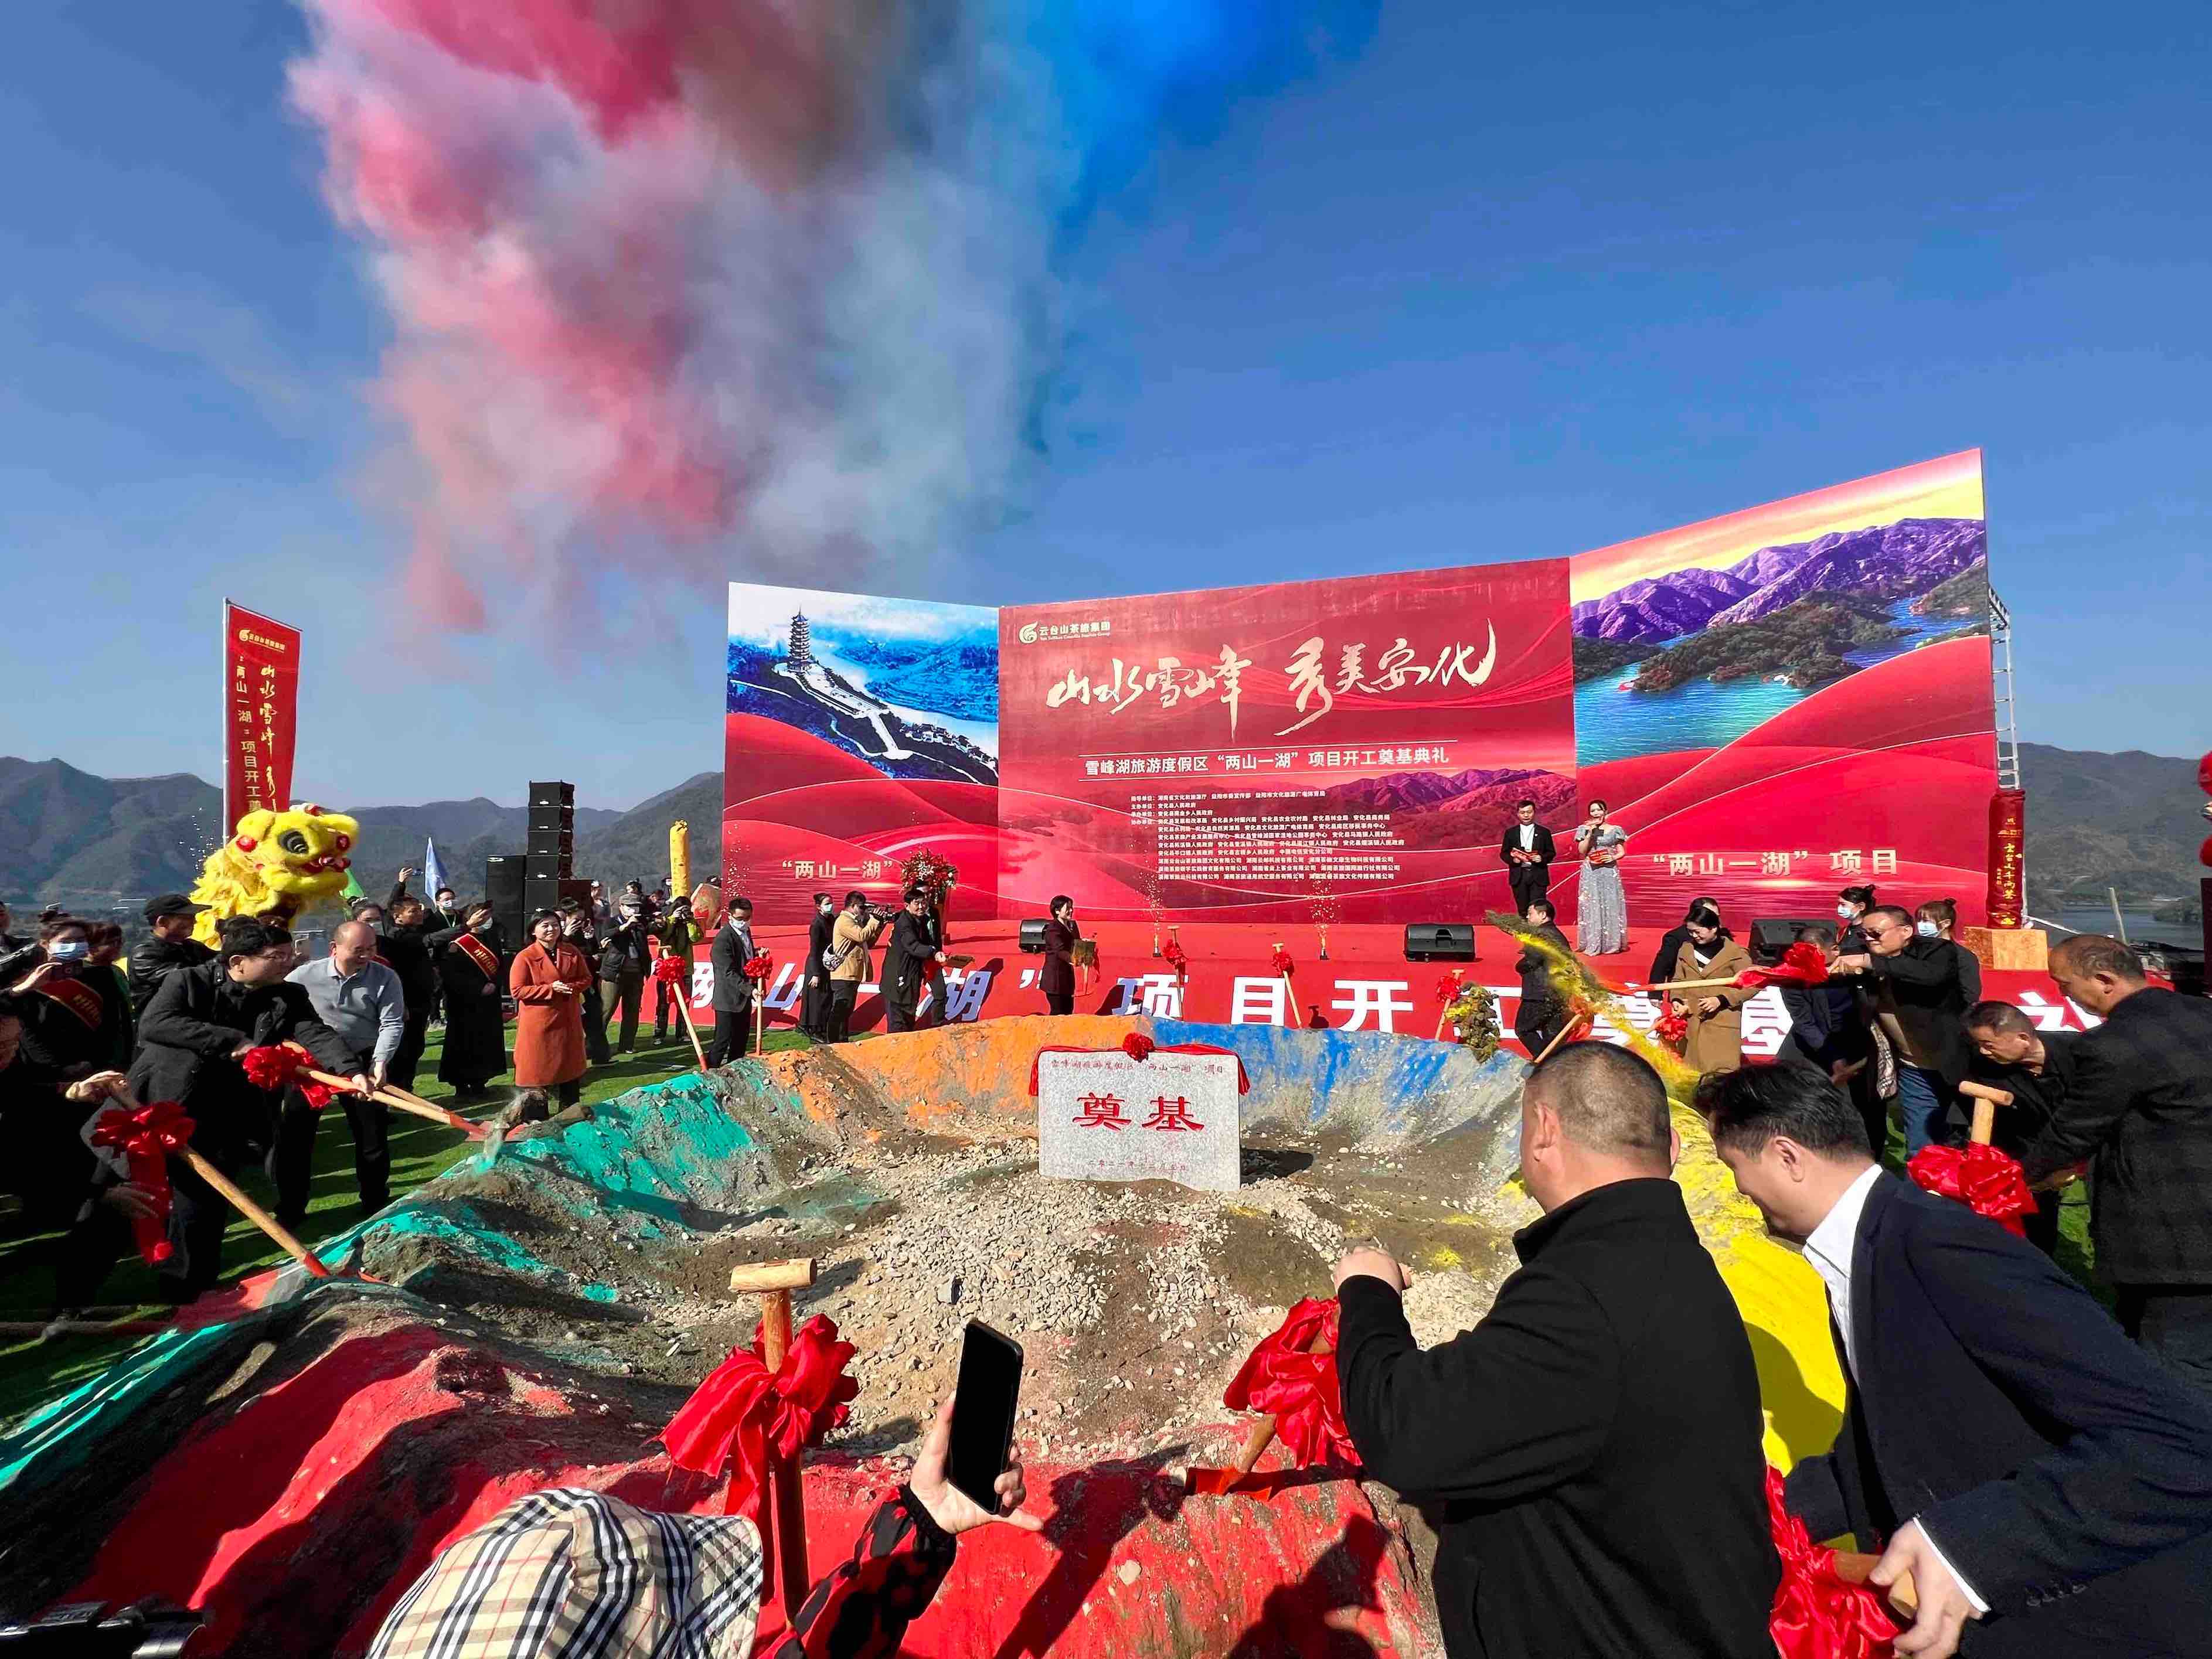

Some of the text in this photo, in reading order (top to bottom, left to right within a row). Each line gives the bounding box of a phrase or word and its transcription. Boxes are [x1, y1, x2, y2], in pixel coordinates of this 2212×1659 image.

[1039, 622, 1111, 636] 云台山茶旅集团
[1046, 617, 1496, 741] 山水雪峰 秀美安化
[782, 860, 893, 880] “两山一湖”
[1072, 1092, 1206, 1132] 奠基
